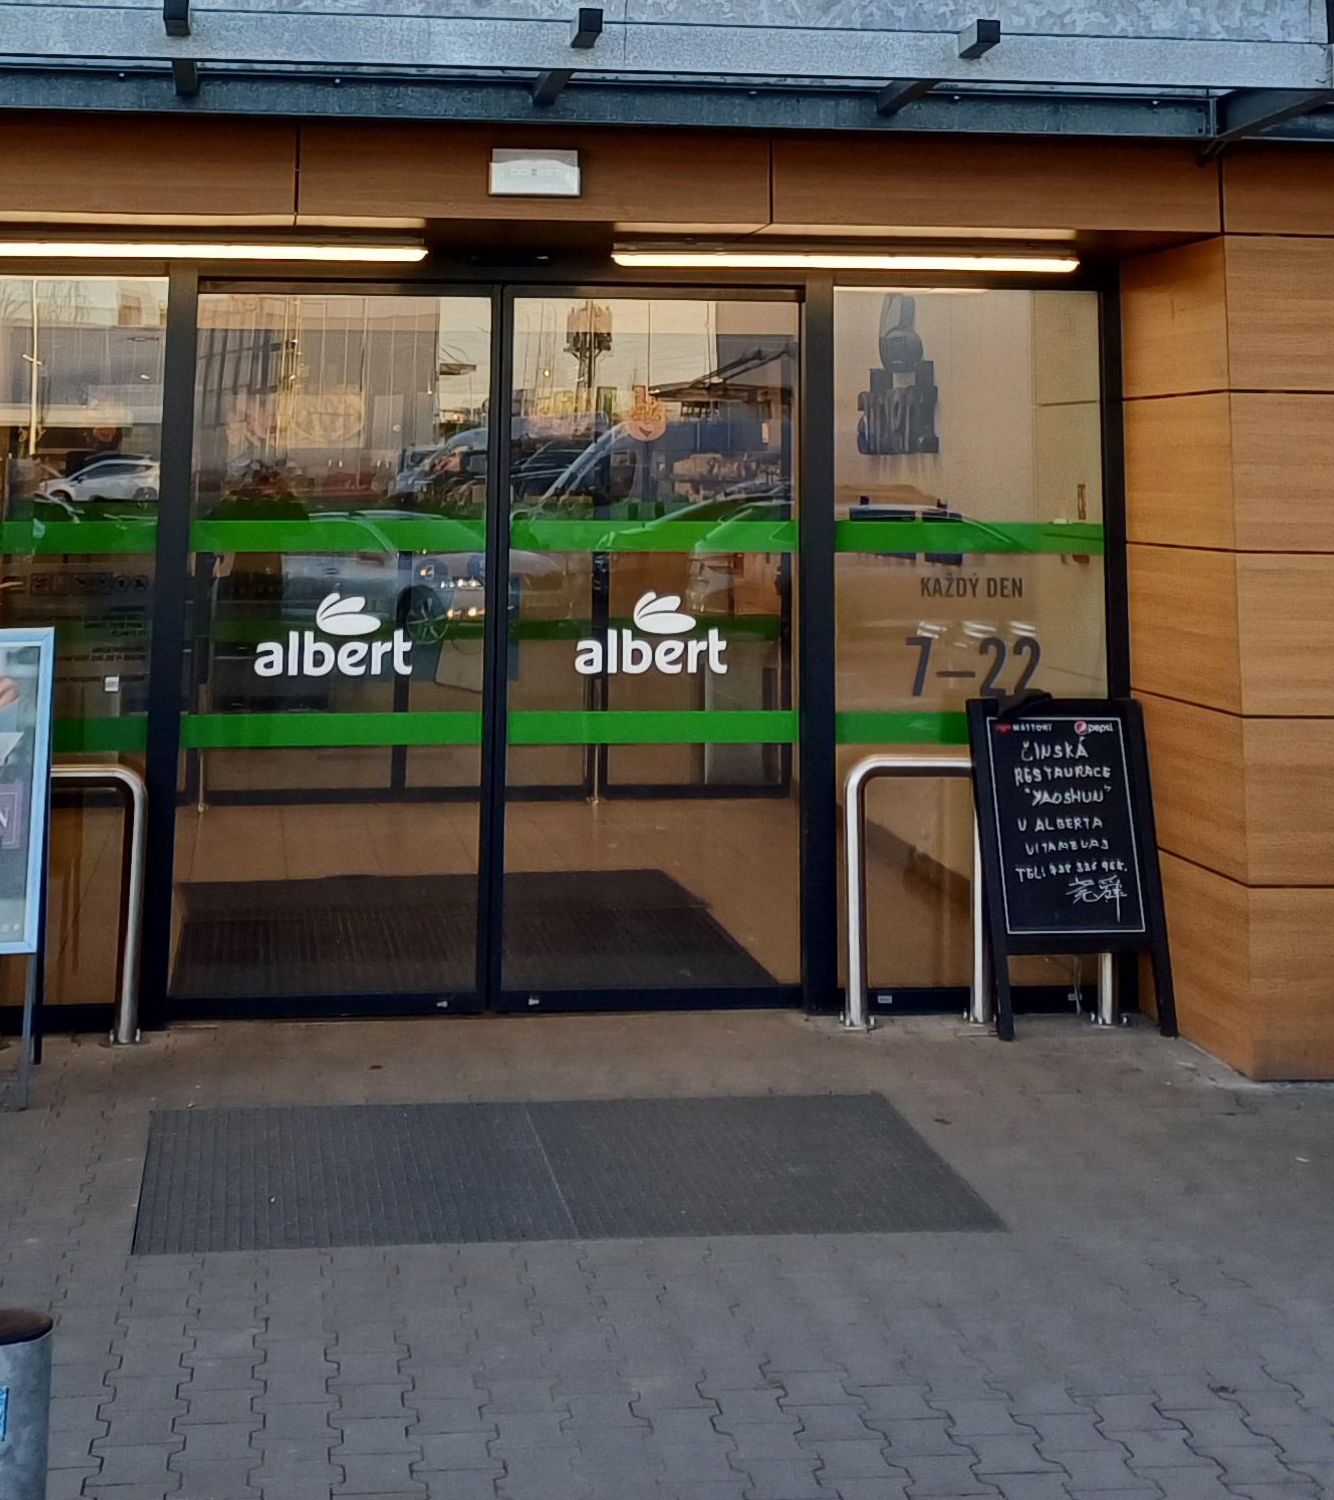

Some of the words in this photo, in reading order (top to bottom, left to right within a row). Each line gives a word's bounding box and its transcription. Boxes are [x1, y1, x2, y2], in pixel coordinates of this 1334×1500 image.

[920, 573, 979, 599] KAŽDÝ
[986, 577, 1023, 598] DEN
[253, 629, 413, 677] albert
[574, 628, 728, 675] albert
[1013, 764, 1112, 787] RESTAURACE
[1017, 817, 1027, 832] U
[1034, 816, 1103, 832] ALBERTA
